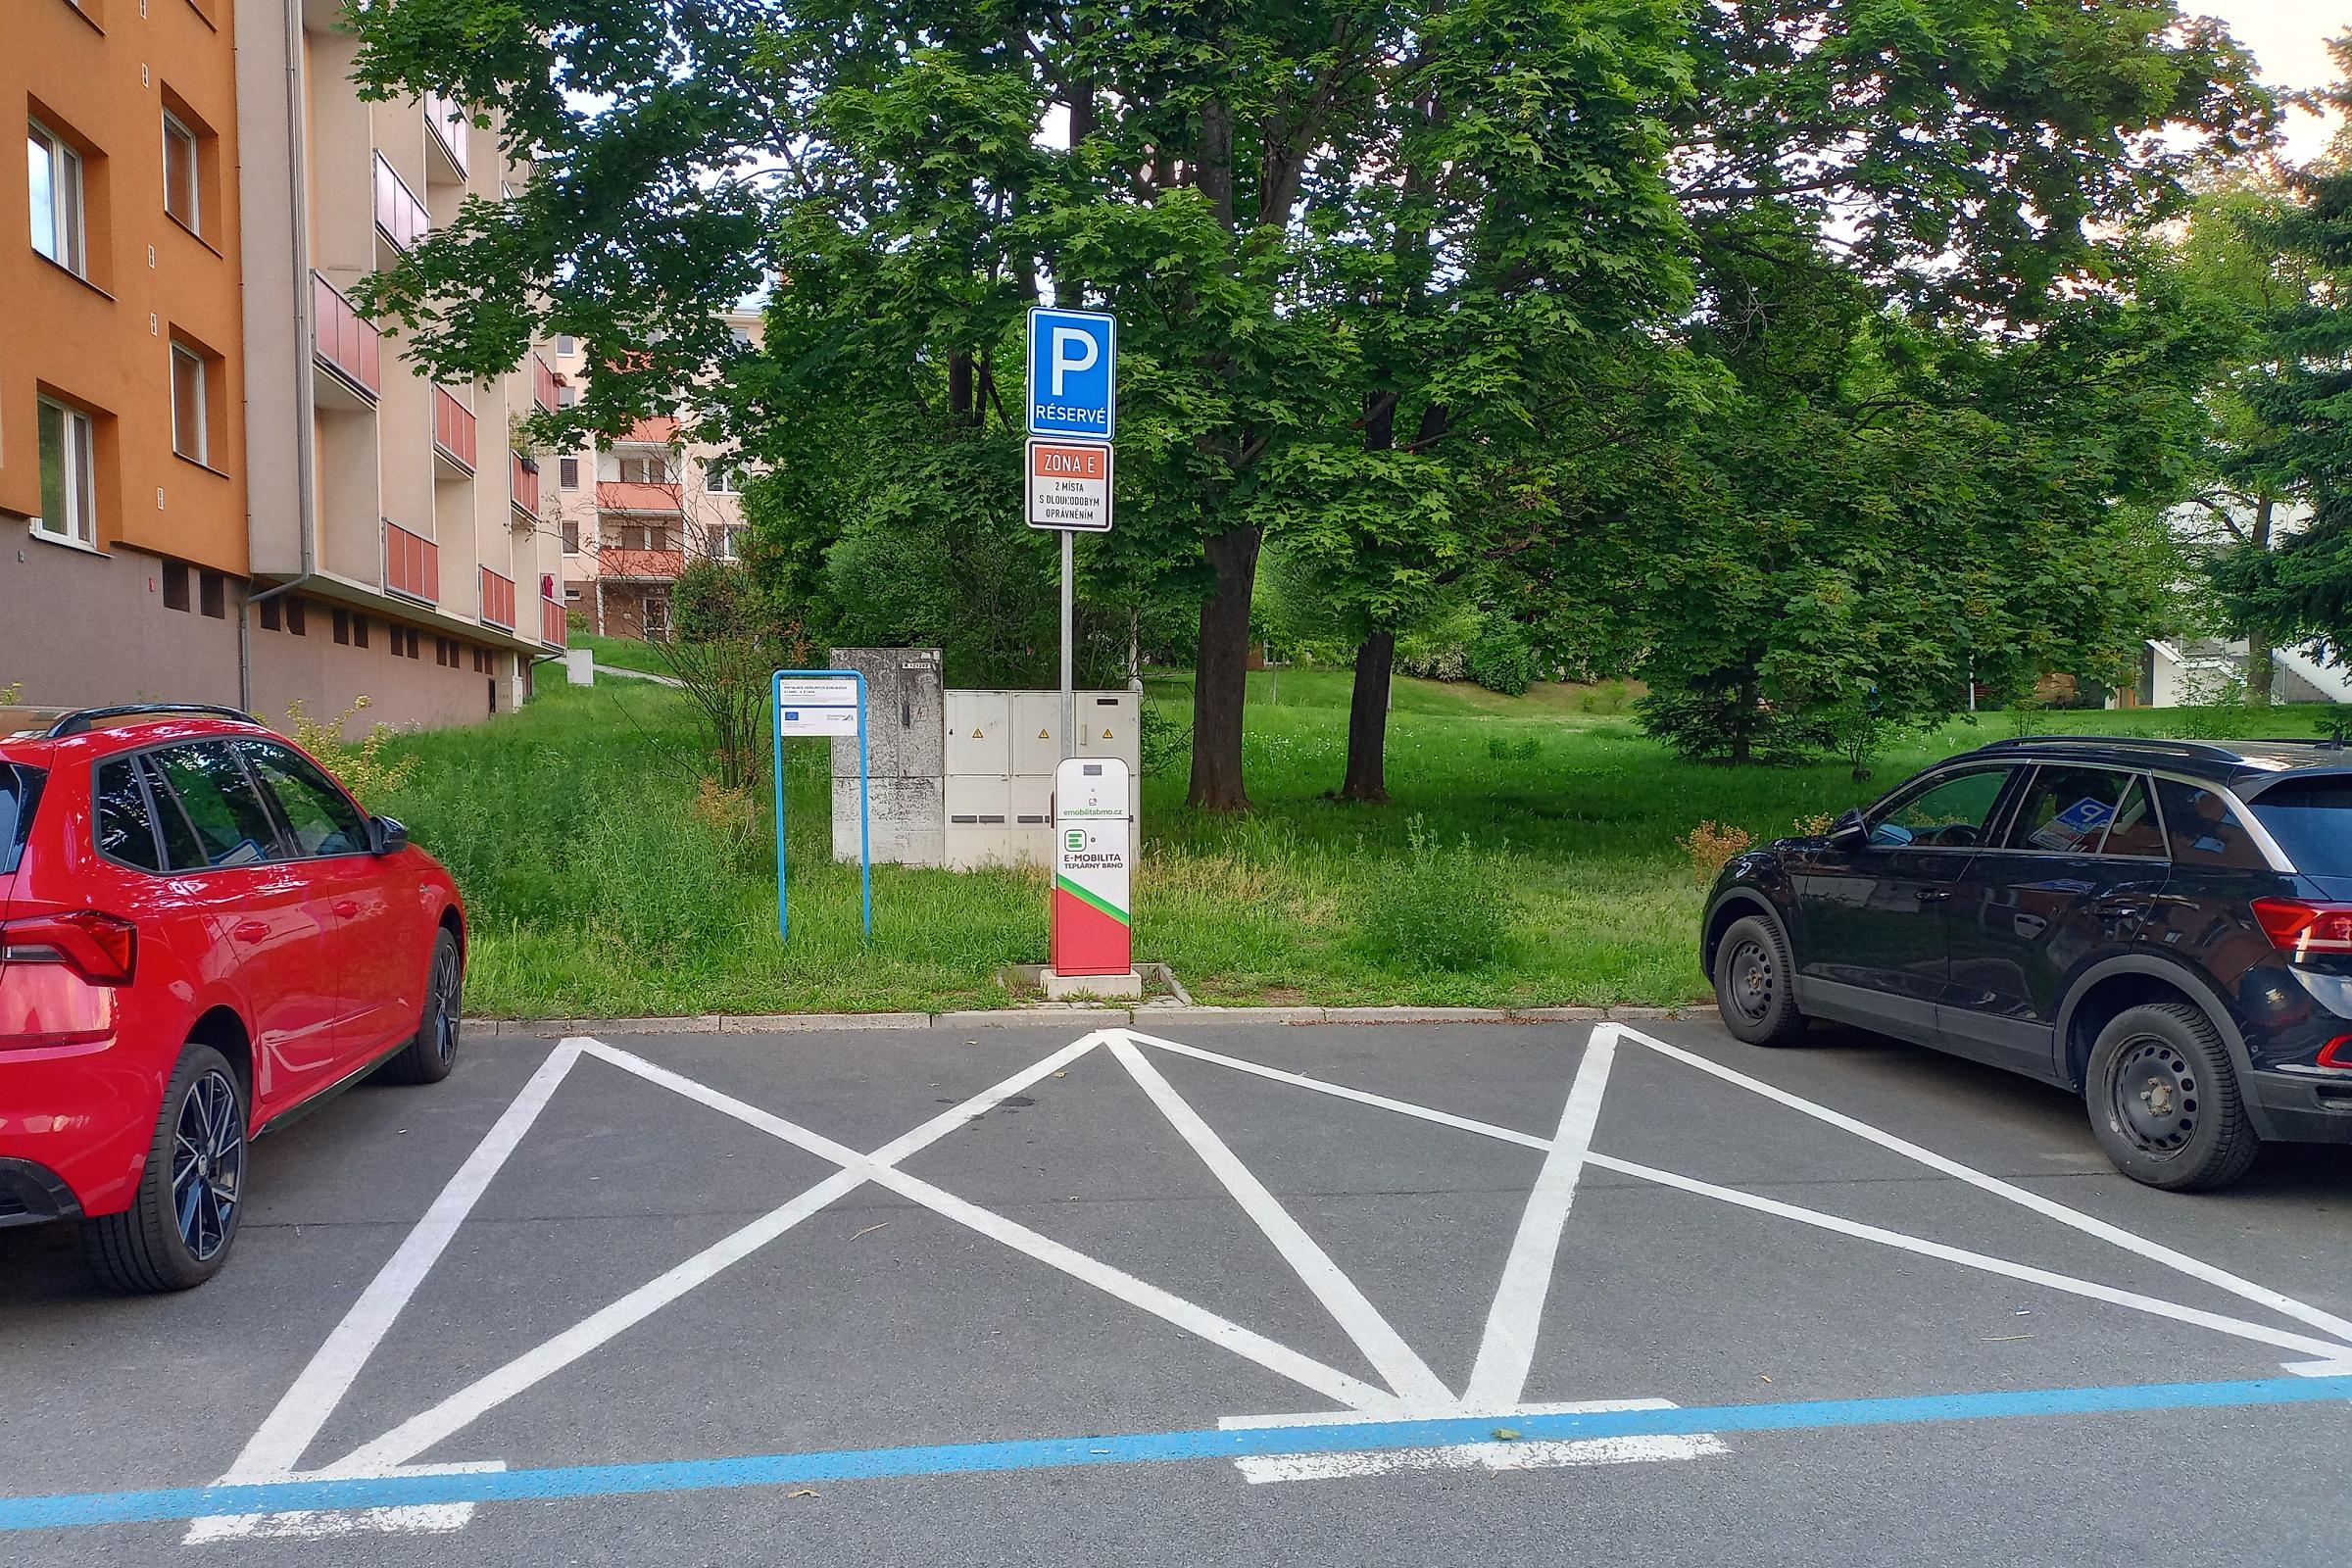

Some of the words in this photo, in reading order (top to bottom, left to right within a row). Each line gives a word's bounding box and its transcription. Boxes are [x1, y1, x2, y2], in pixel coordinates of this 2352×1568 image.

[1052, 326, 1099, 396] P
[1036, 402, 1105, 424] RÉSERVÉ
[1044, 451, 1081, 472] ZÓNA
[1087, 456, 1095, 473] E
[1054, 481, 1059, 491] 2
[1061, 480, 1084, 492] MÍSTA
[1039, 494, 1045, 504] S
[1046, 494, 1100, 507] DLOUHODOBÝM
[1046, 507, 1094, 520] OPRÁVNĚNÍM
[1063, 854, 1121, 862] E-MOBILITA
